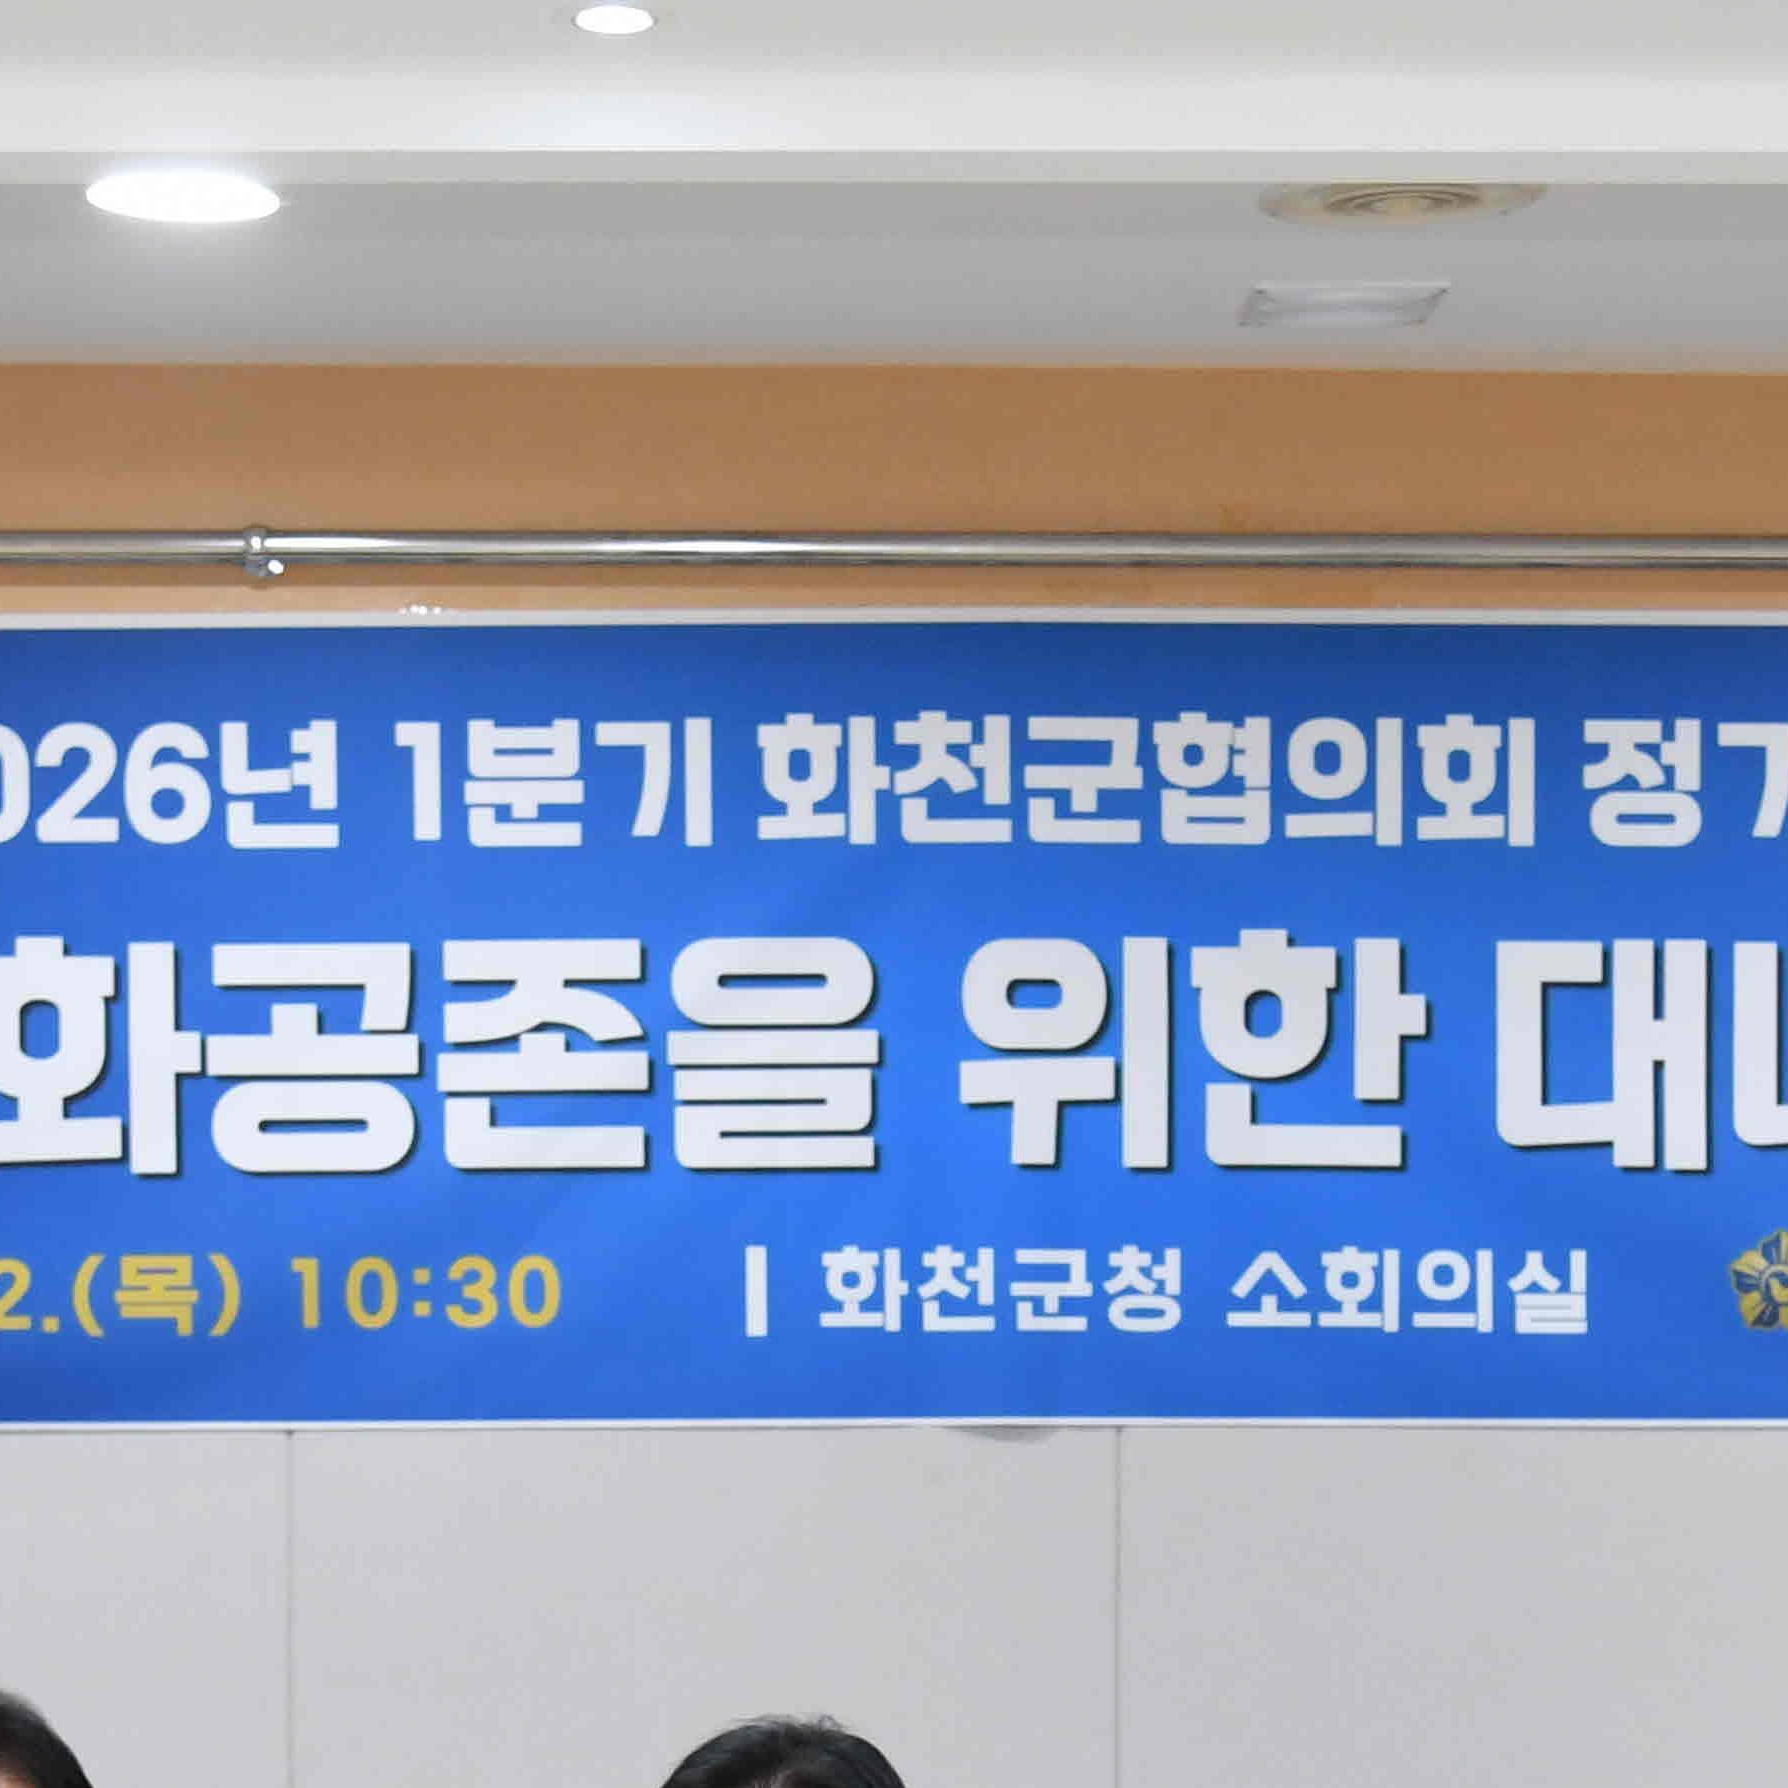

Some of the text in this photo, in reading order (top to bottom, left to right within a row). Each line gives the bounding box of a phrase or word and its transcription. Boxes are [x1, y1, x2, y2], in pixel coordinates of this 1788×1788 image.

[394, 717, 713, 848] 1분기
[757, 710, 1535, 847] 화천군협의회
[959, 929, 1426, 1168] 위한
[292, 1255, 561, 1329] 10:30
[820, 1245, 1588, 1334] 화천군청 소회의실
